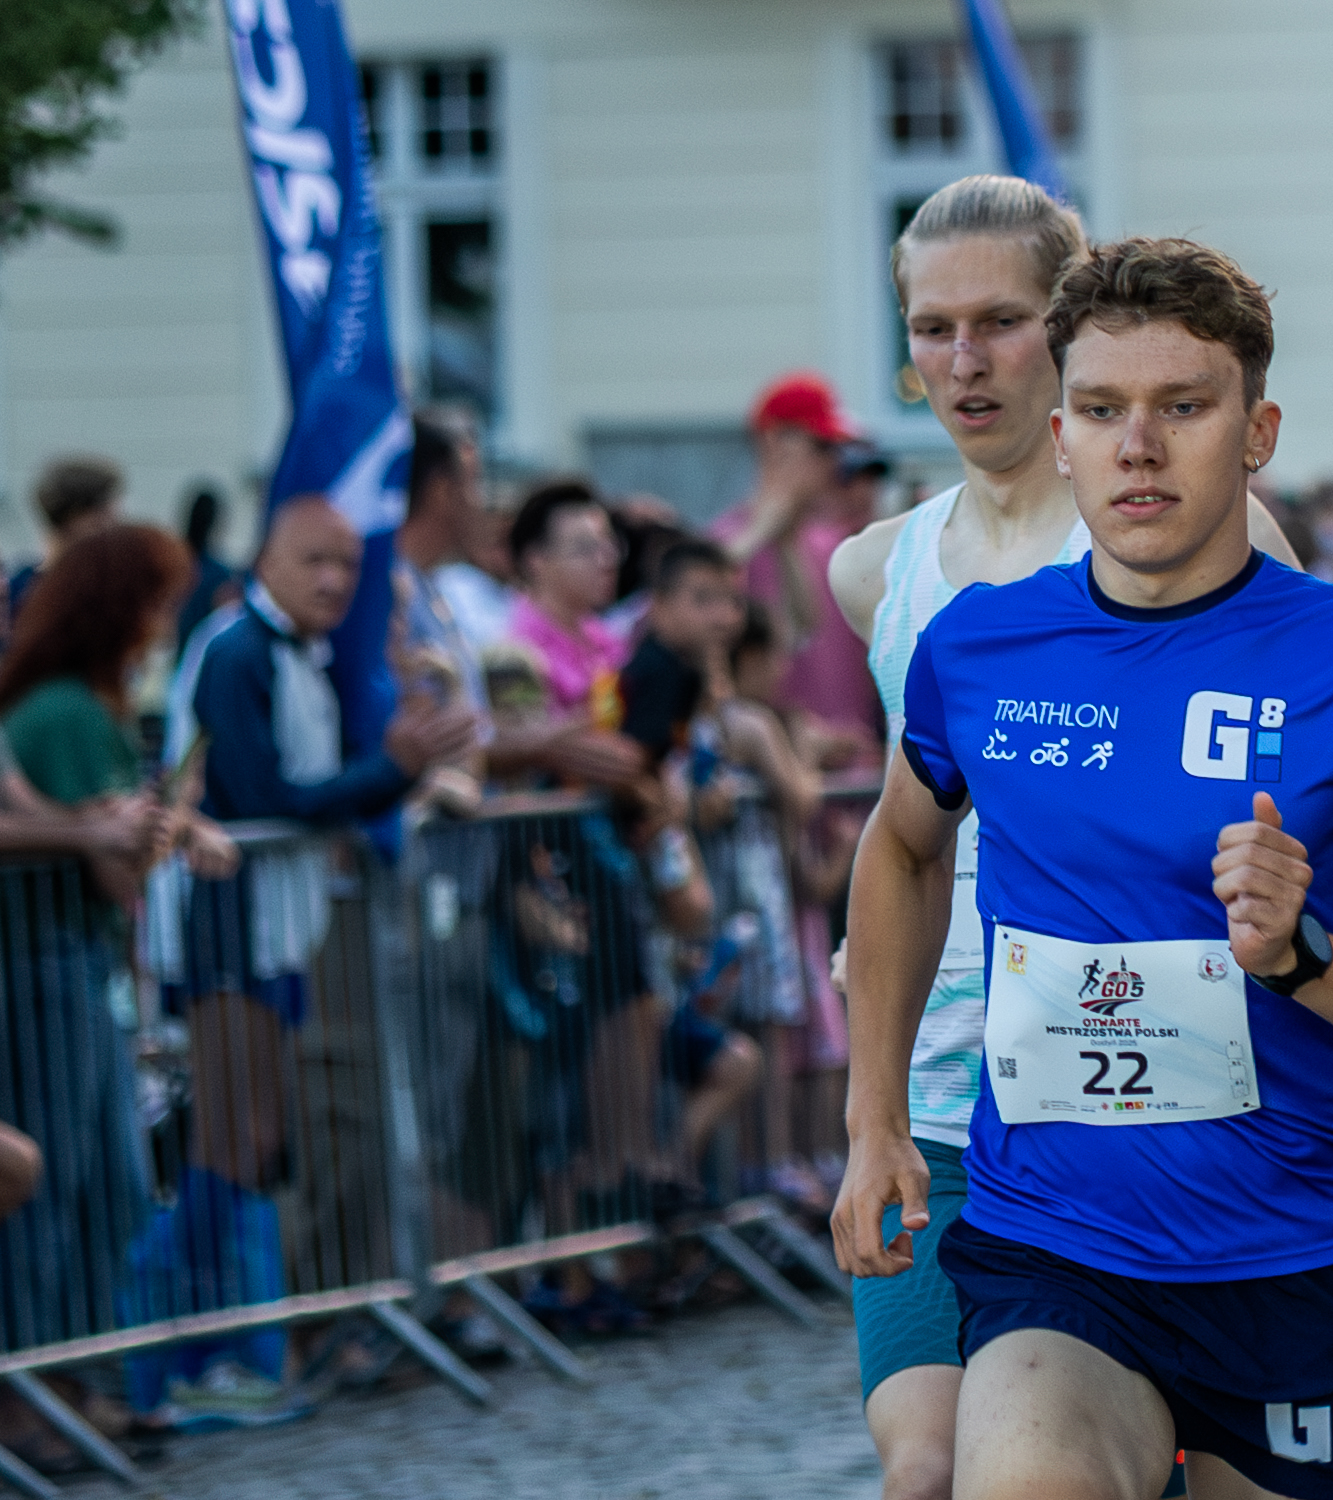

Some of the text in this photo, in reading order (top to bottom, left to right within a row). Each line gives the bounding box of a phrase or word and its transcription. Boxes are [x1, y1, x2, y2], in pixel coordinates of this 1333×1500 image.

[994, 700, 1119, 730] TRIATHLON
[1045, 1026, 1179, 1038] MISTRZOSTWA POLSKI
[1082, 1018, 1141, 1028] OTWARTE
[1079, 1051, 1154, 1096] 22
